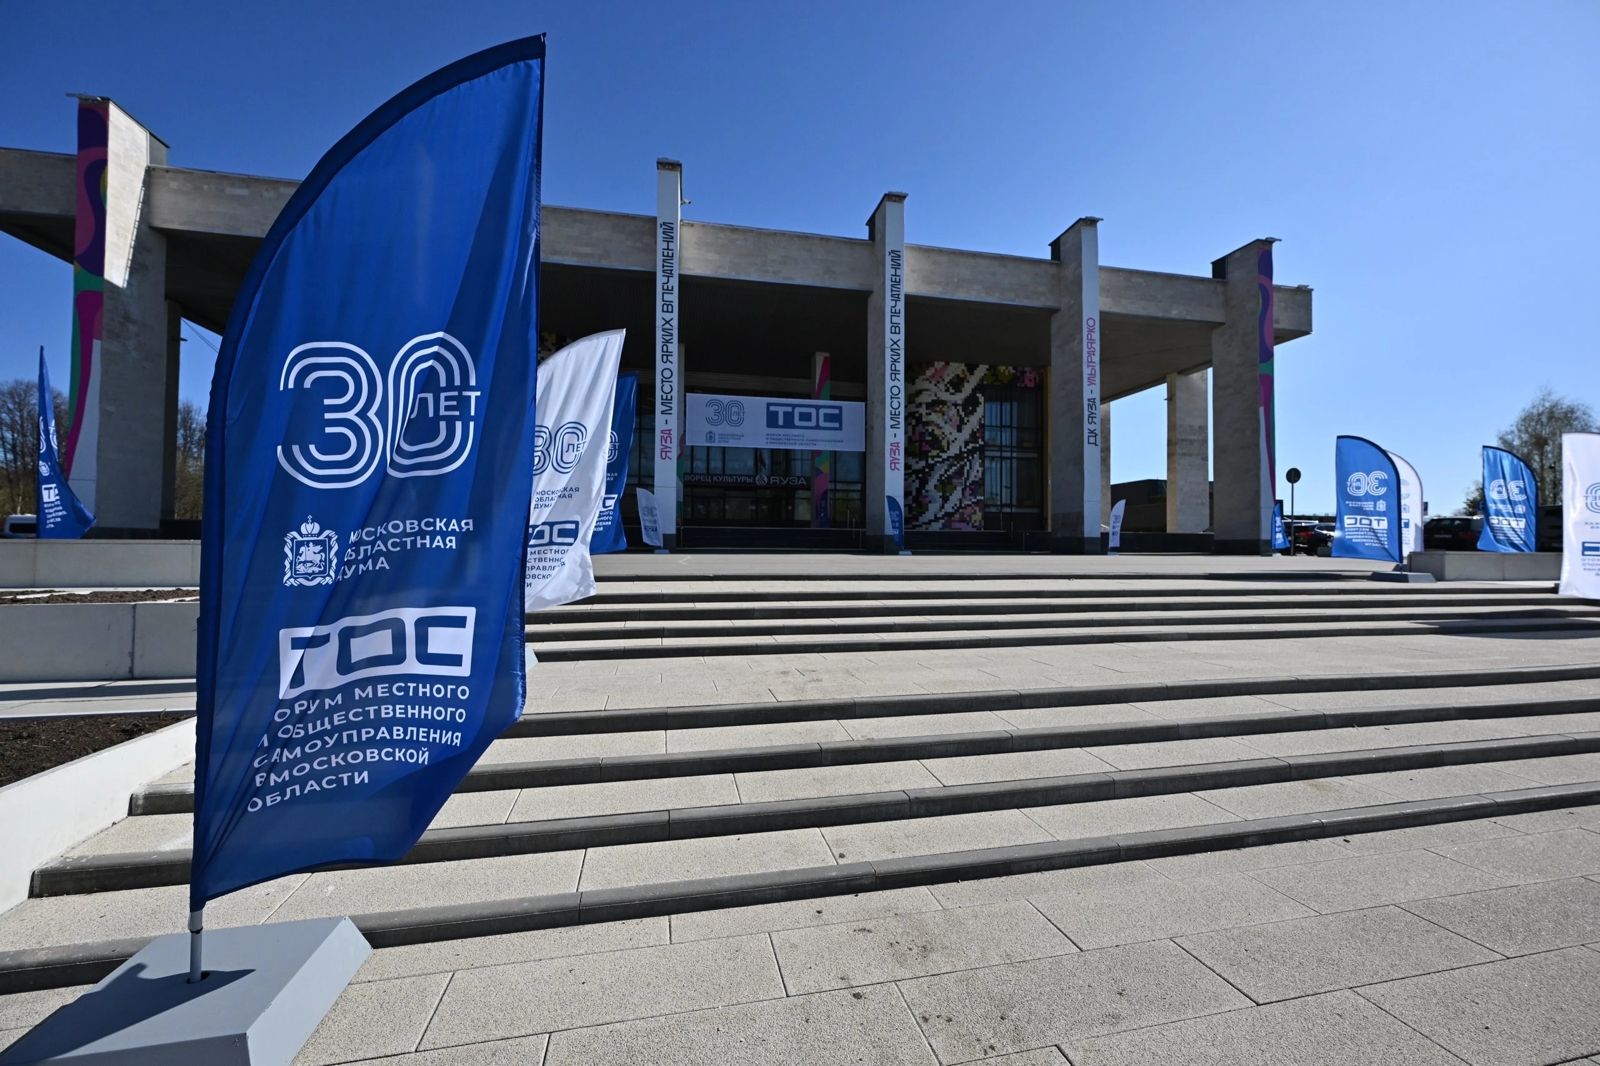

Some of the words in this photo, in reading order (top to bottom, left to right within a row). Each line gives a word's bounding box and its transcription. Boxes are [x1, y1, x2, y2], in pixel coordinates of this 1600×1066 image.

[659, 221, 674, 314] ВПЕЧАТЛЕНИЙ
[888, 249, 902, 335] ВПЕЧАТЛЕНИЙ
[660, 316, 673, 364] ЯРКИХ
[889, 337, 901, 382] ЯРКИХ
[1086, 317, 1096, 386] УЛЬТРАЯРКО
[277, 331, 476, 489] 30
[410, 391, 481, 419] ЛЕТ
[660, 367, 673, 416] МЕСТО
[889, 384, 901, 430] МЕСТО
[1087, 398, 1096, 423] ЯУЗА
[705, 399, 745, 428] 30
[767, 404, 842, 429] ТОС
[660, 429, 672, 460] ЯУЗА
[889, 442, 900, 471] ЯУЗА
[1087, 427, 1098, 446] ДК
[684, 474, 711, 483] ВОРЕЦ
[770, 476, 808, 486] ЯУЗА
[344, 535, 457, 561] БЛАСТНАЯ
[528, 523, 577, 546] ОС
[274, 692, 342, 722] ОРУМ
[354, 682, 470, 700] МЕСТНОГО
[277, 704, 466, 738] ОБЩЕСТВЕННОГО
[253, 726, 462, 768] САМОУПРАВЛЕНИЯ
[269, 746, 430, 787] МОСКОВСКОЙ
[247, 770, 369, 812] ОБЛАСТИ
